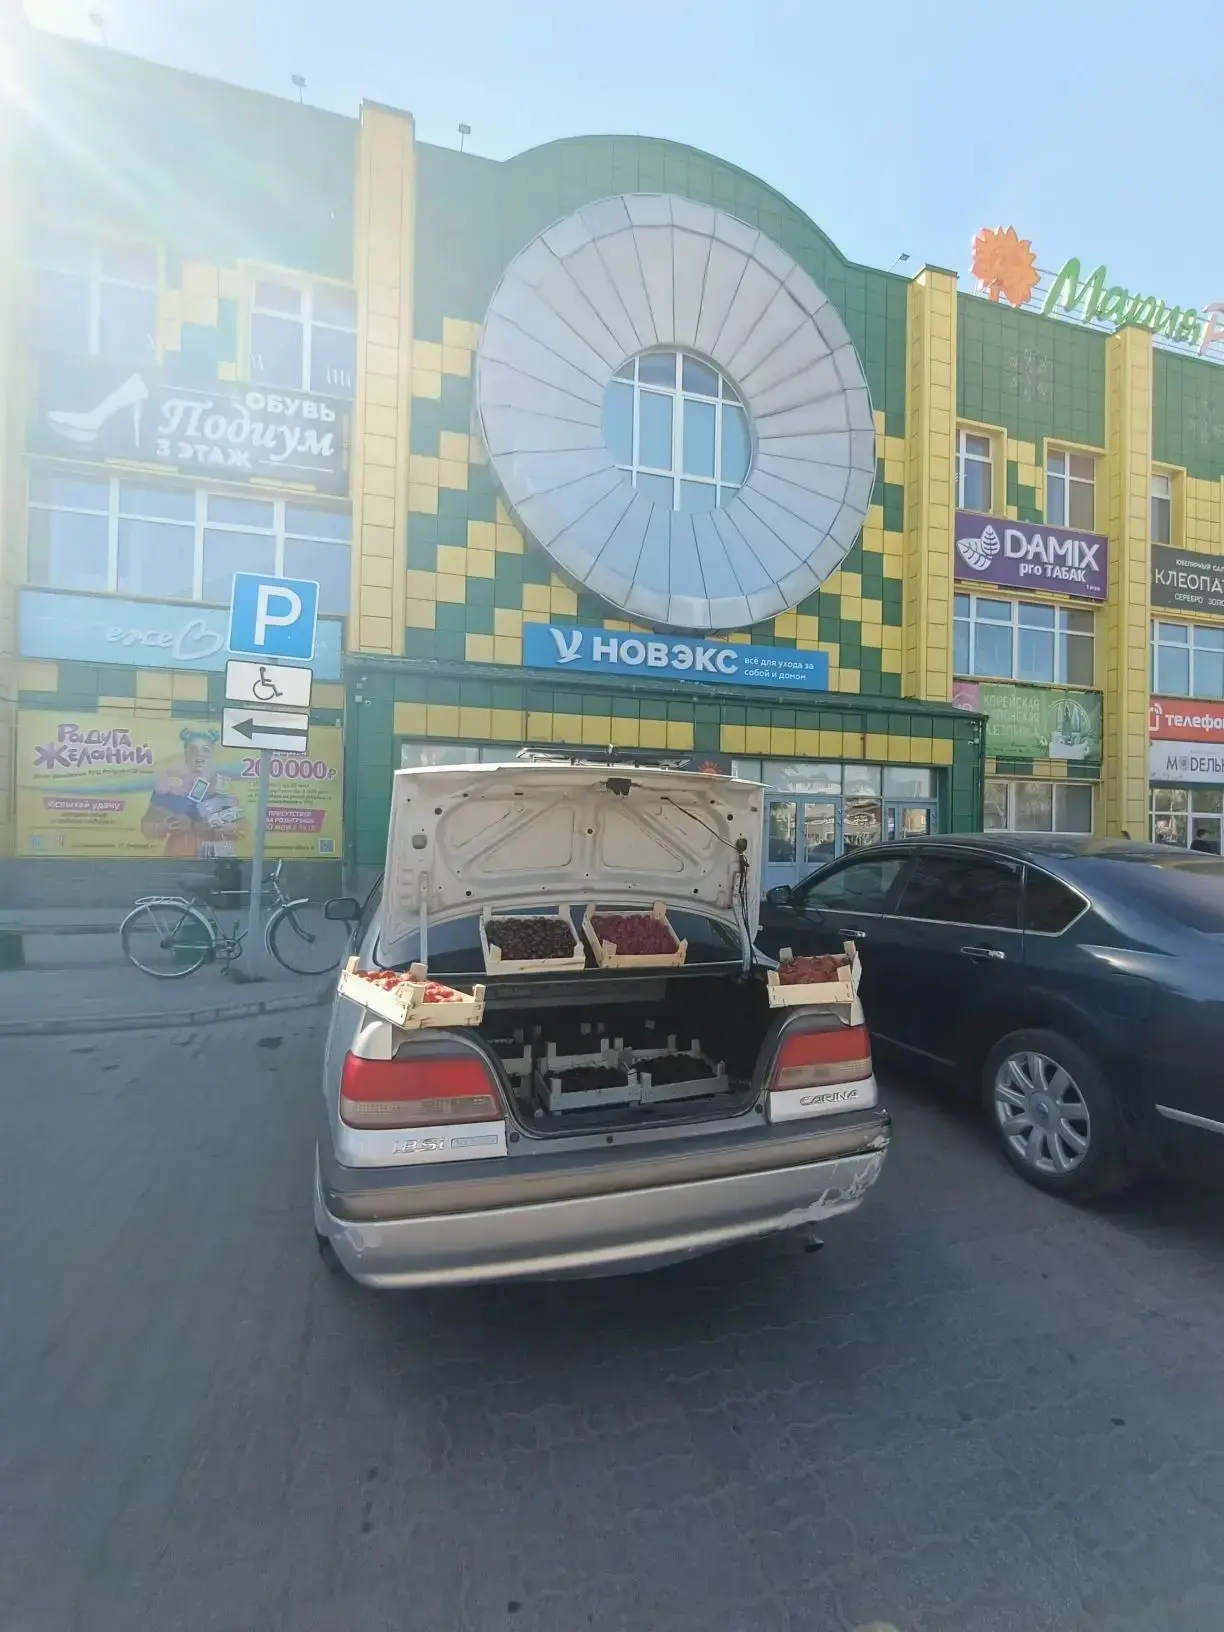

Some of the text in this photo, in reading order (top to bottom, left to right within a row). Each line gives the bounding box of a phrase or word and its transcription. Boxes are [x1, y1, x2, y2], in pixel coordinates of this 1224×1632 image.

[1041, 257, 1200, 346] Мария
[245, 392, 336, 422] ОБУВЬ
[157, 399, 335, 462] Подиум
[178, 441, 250, 469] ЭТАЖ
[1004, 528, 1100, 572] DAMIX
[1019, 562, 1087, 583] pro ТАБАК
[1155, 568, 1224, 594] КЛЕОПА
[1174, 593, 1204, 605] СЕРЕБРО
[254, 584, 302, 646] P
[592, 636, 739, 675] НОВЭКС
[744, 656, 759, 665] всё
[760, 659, 777, 667] для
[778, 660, 803, 669] ухода
[744, 668, 770, 678] собой
[1165, 713, 1224, 733] телефо
[800, 1089, 859, 1107] CARINA
